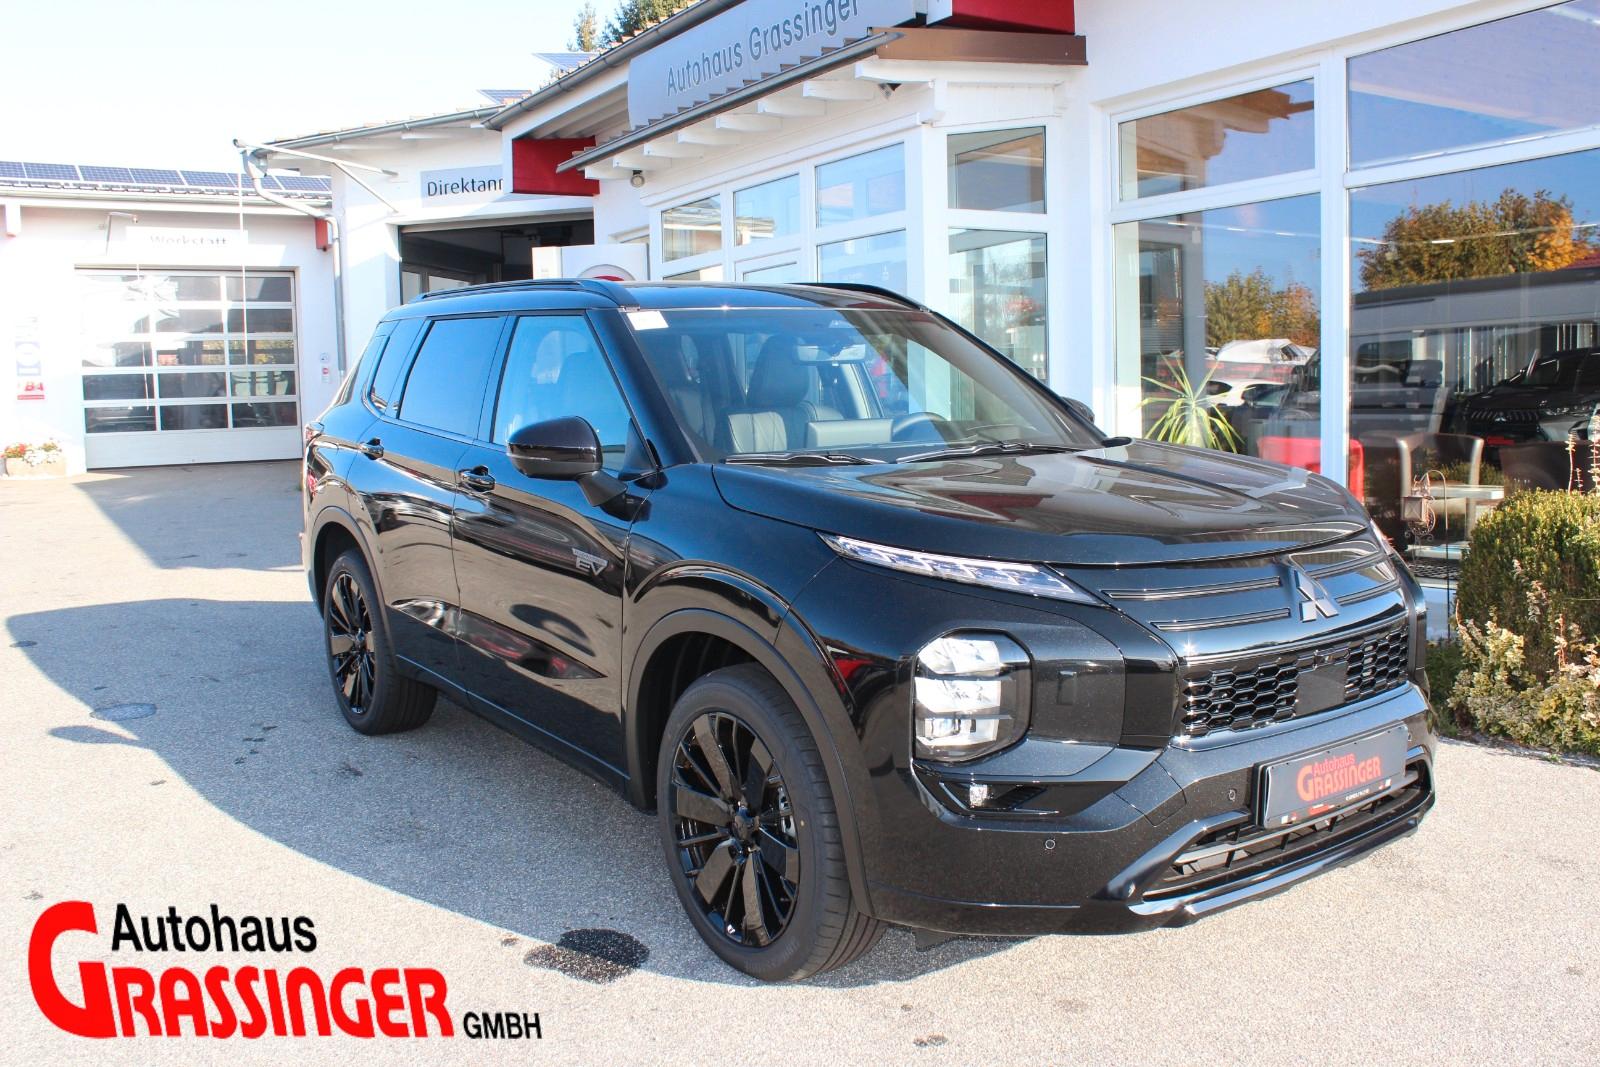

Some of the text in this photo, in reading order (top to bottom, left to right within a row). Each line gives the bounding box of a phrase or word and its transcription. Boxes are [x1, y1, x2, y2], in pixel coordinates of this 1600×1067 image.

[667, 42, 743, 96] Autohaus
[1297, 756, 1382, 801] GRASSINGER
[1314, 754, 1354, 774] Autohaus
